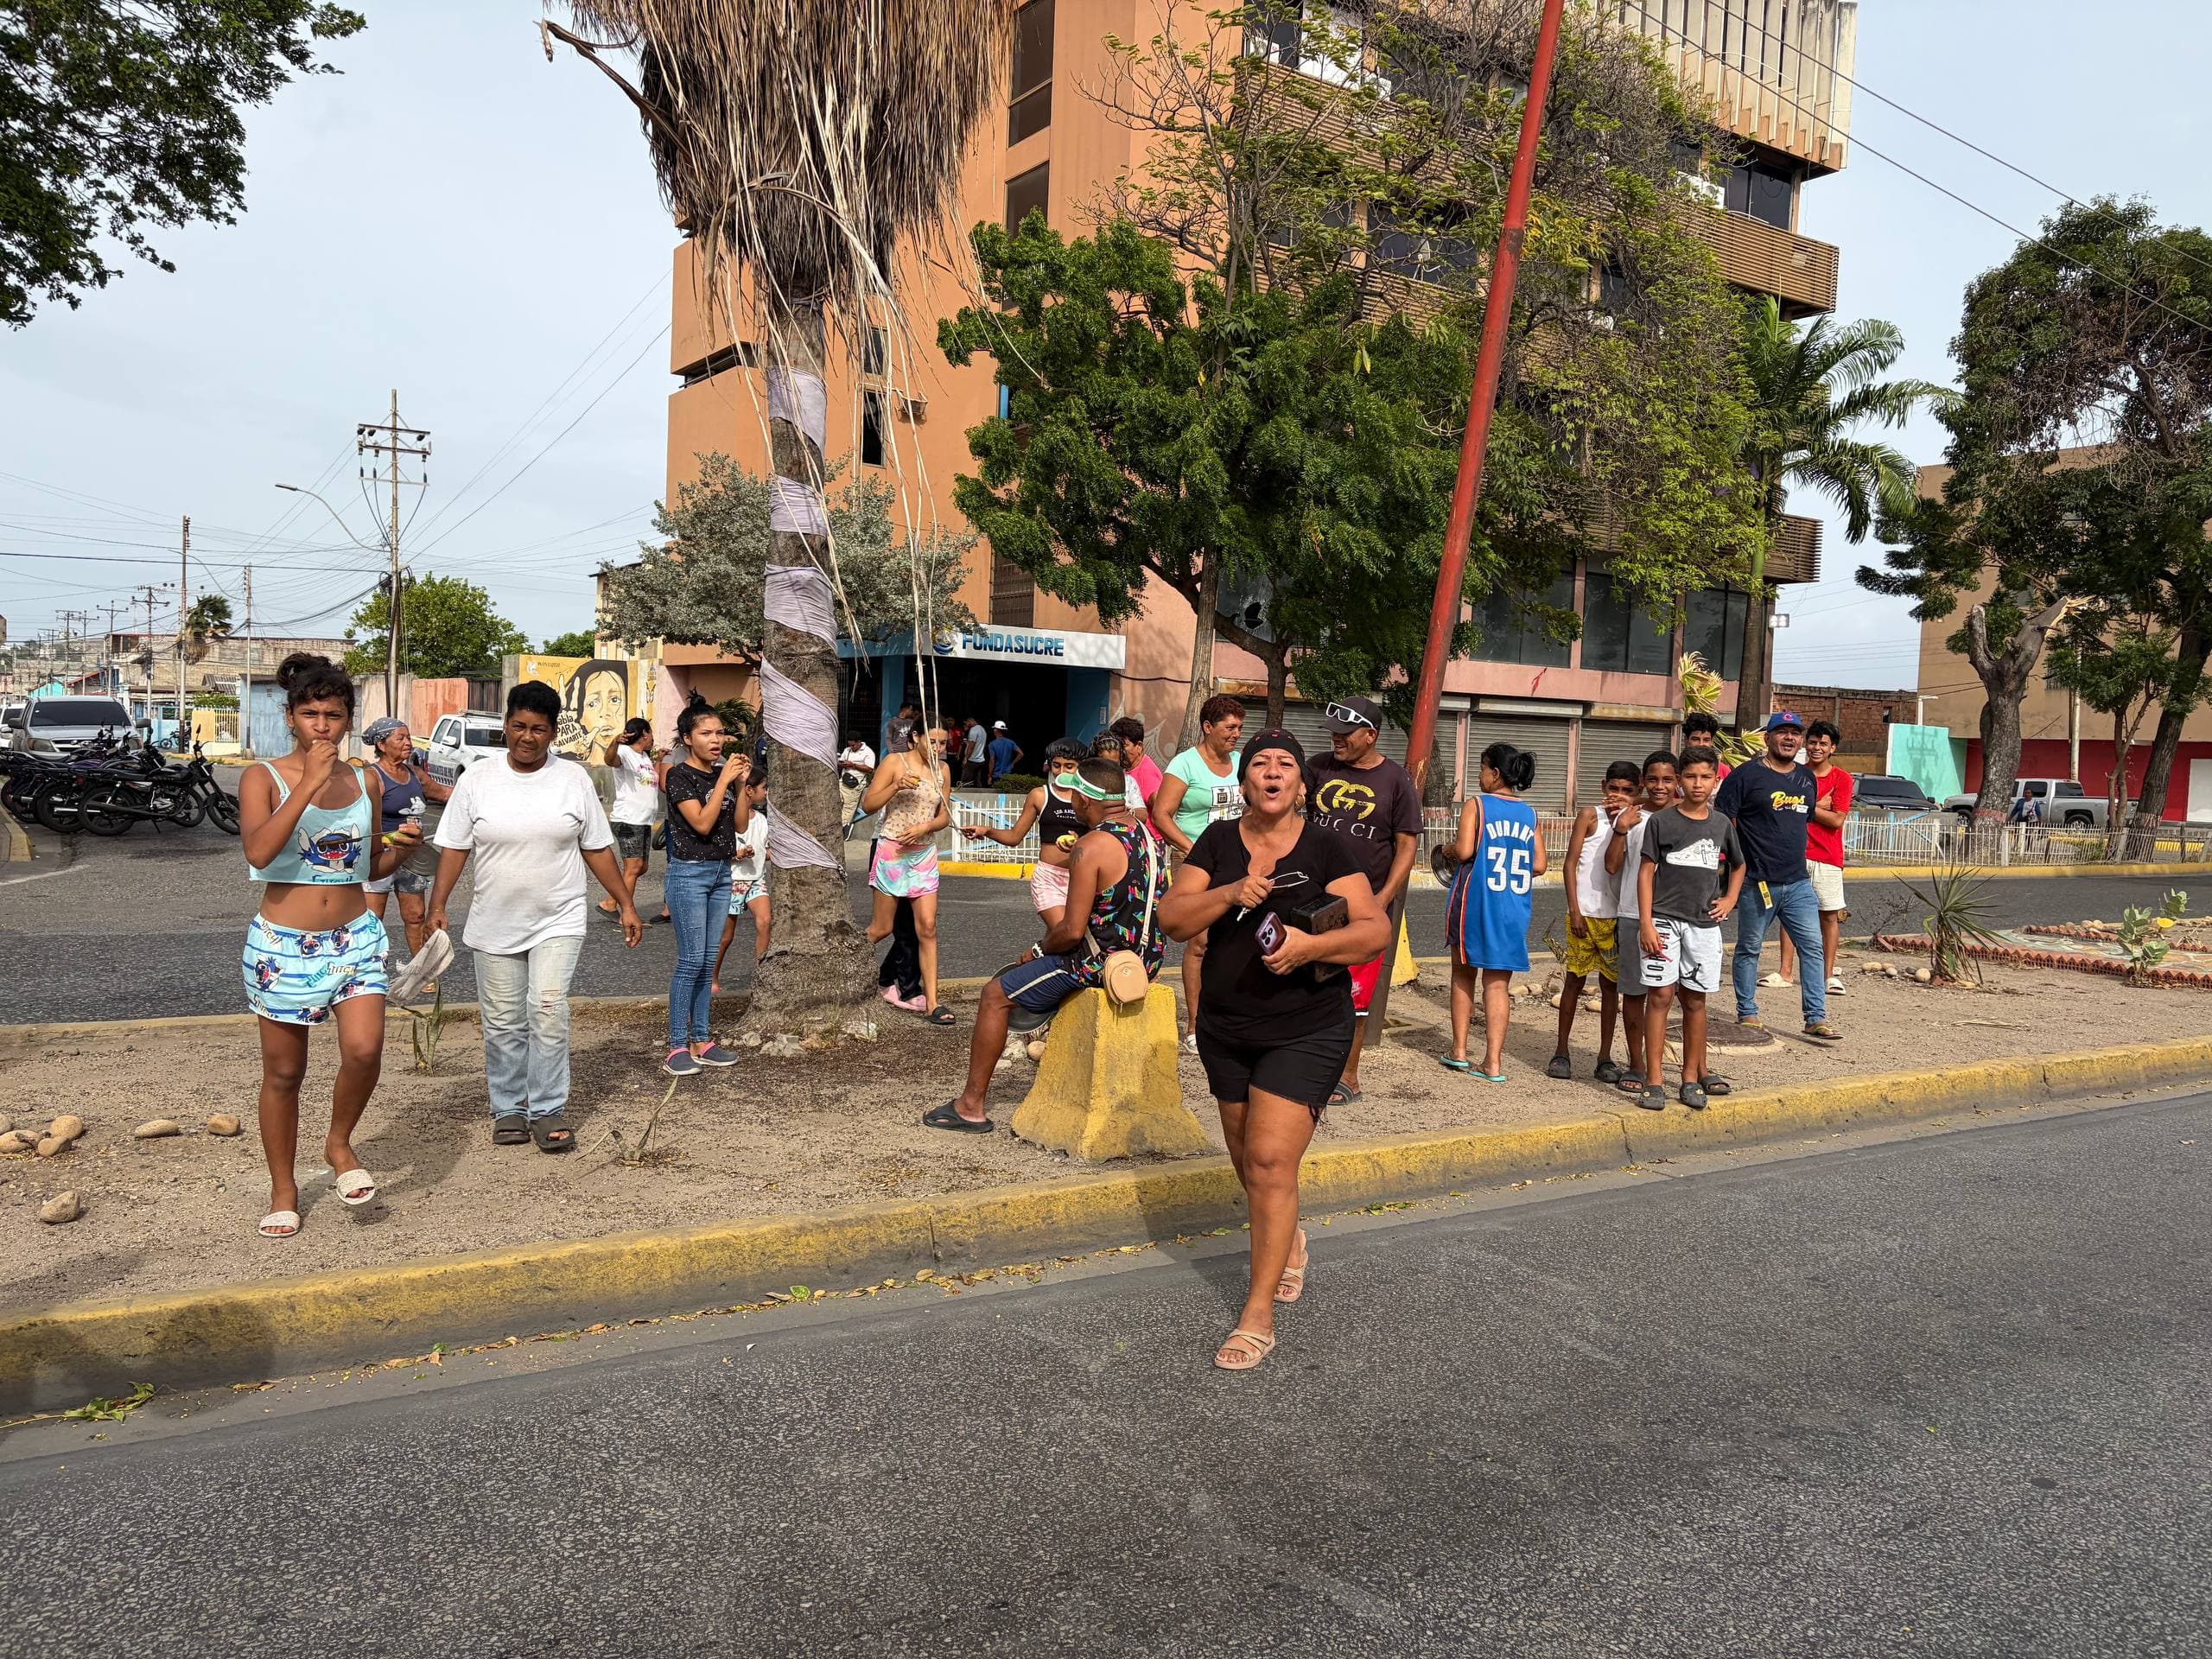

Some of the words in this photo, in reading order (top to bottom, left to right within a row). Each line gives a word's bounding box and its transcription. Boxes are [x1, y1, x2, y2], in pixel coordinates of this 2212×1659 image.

[962, 632, 1065, 657] FUNDASUCRE
[553, 733, 582, 747] SALVARTE
[1486, 819, 1535, 844] DURANT
[1487, 846, 1531, 895] 35
